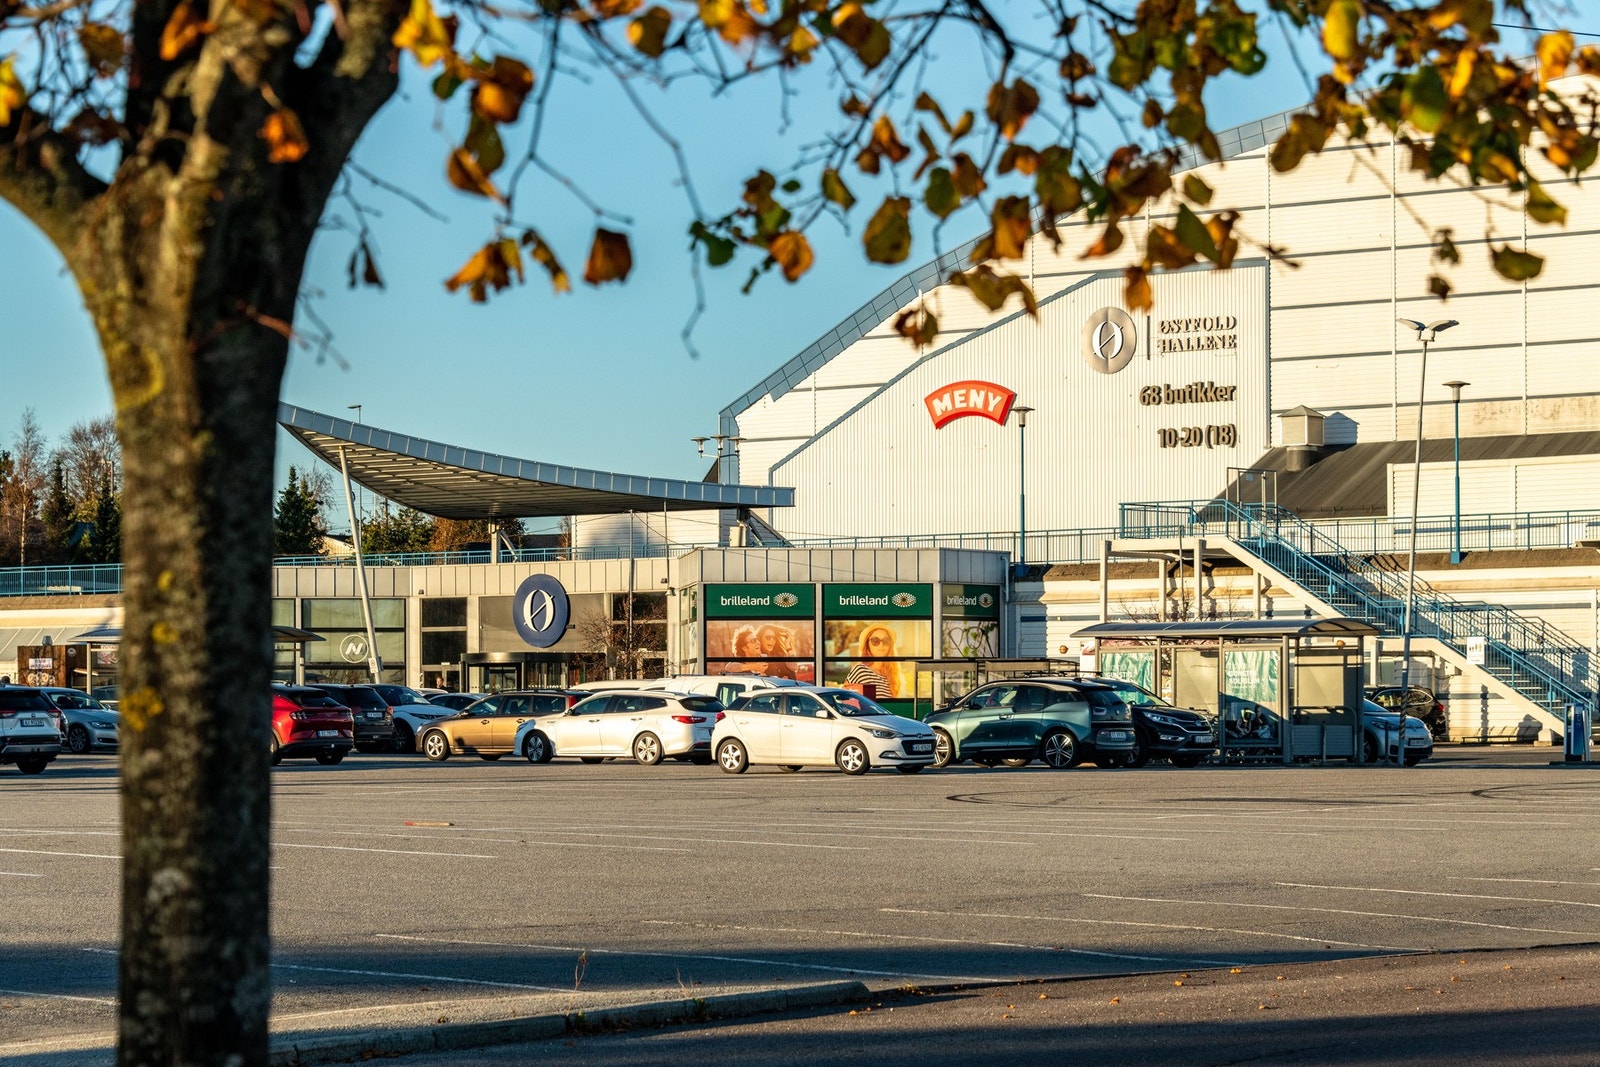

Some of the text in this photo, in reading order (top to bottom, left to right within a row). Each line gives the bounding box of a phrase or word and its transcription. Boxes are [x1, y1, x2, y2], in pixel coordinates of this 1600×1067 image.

[1158, 315, 1237, 334] ØSTFOLD
[1157, 334, 1237, 352] HALLENE
[1139, 381, 1236, 406] 68 butikker
[931, 388, 1003, 418] MENY
[1157, 423, 1237, 449] 10-20 (18)
[720, 595, 770, 607] brilleland
[839, 595, 888, 607] brilleland
[946, 594, 977, 607] brilleland
